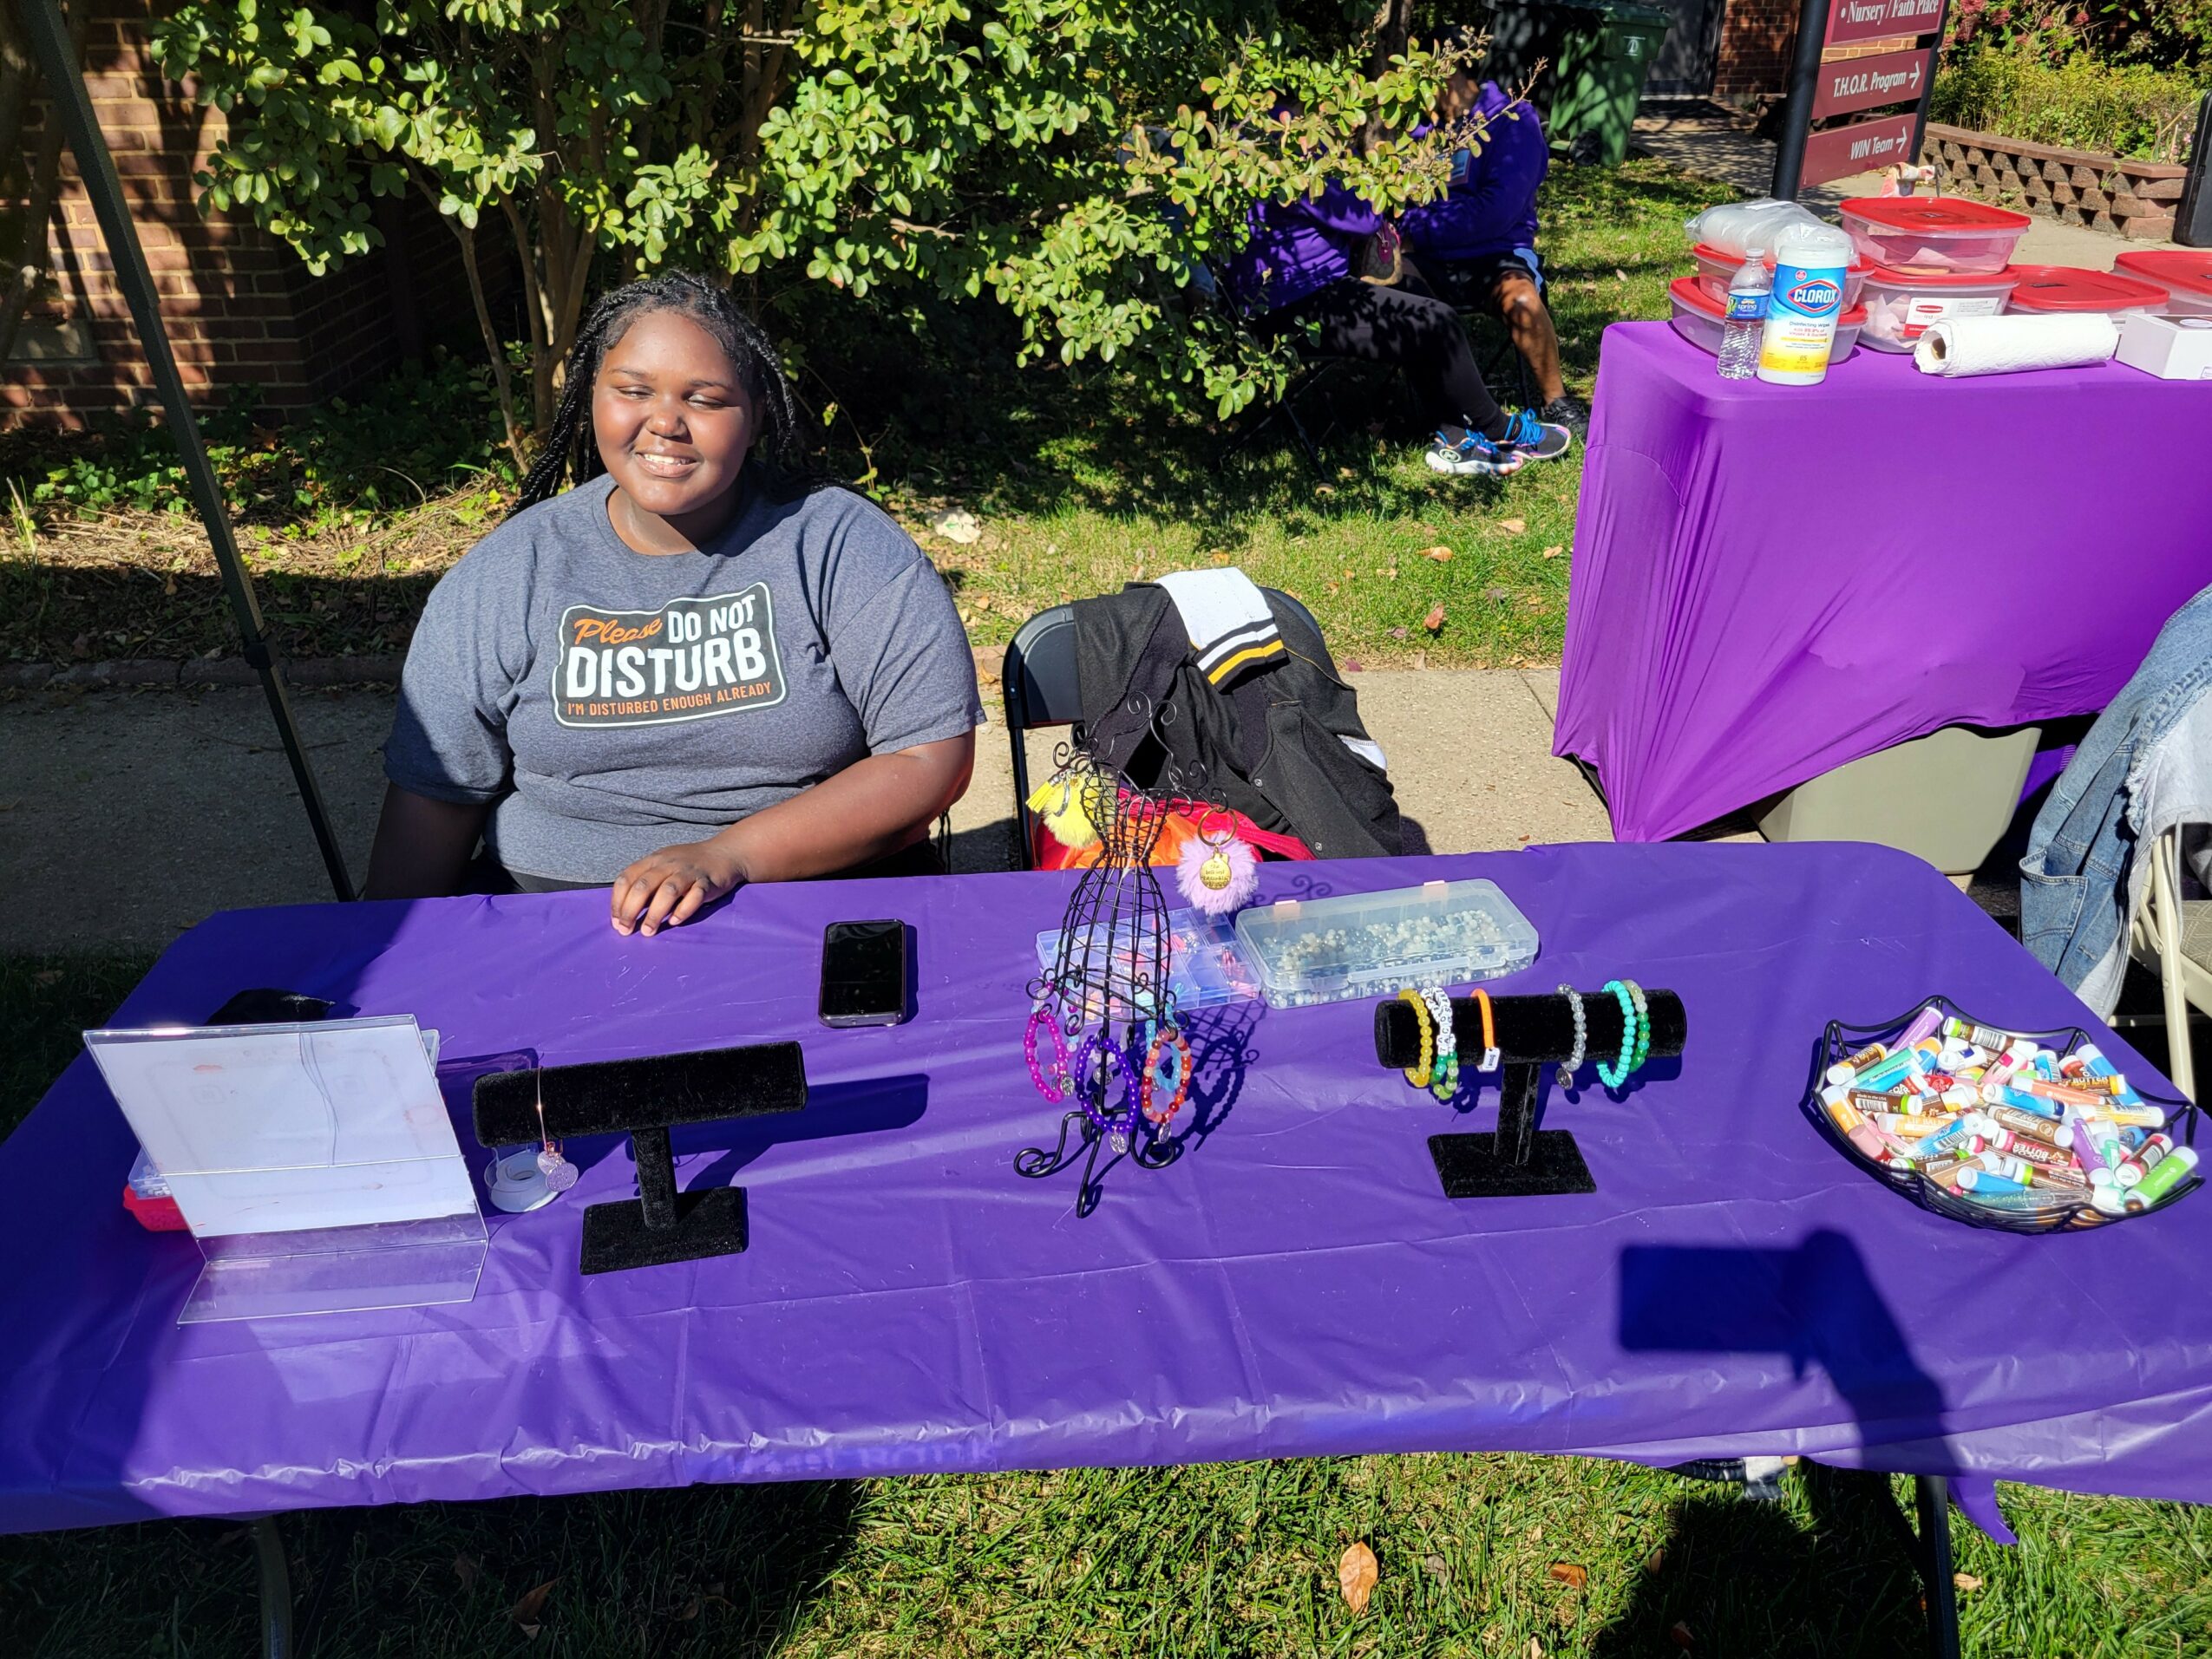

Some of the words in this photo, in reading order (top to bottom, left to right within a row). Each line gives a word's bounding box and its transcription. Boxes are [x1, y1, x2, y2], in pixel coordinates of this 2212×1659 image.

[1847, 2, 1886, 25] Nursery
[1891, 0, 1914, 17] Faith
[1915, 0, 1940, 15] Place
[1833, 74, 1868, 97] T.H.O.R.
[1870, 71, 1908, 93] Program
[1850, 139, 1871, 160] WIN
[1872, 136, 1894, 154] Team
[1794, 289, 1836, 303] CLOROX
[573, 617, 663, 645] Please
[667, 611, 702, 643] DO
[710, 594, 756, 636] NOT
[566, 628, 766, 698] DISTURB
[567, 703, 584, 715] I'M
[589, 700, 658, 716] DISTURBED
[663, 692, 712, 711] ENOUGH
[717, 682, 772, 702] ALREADY
